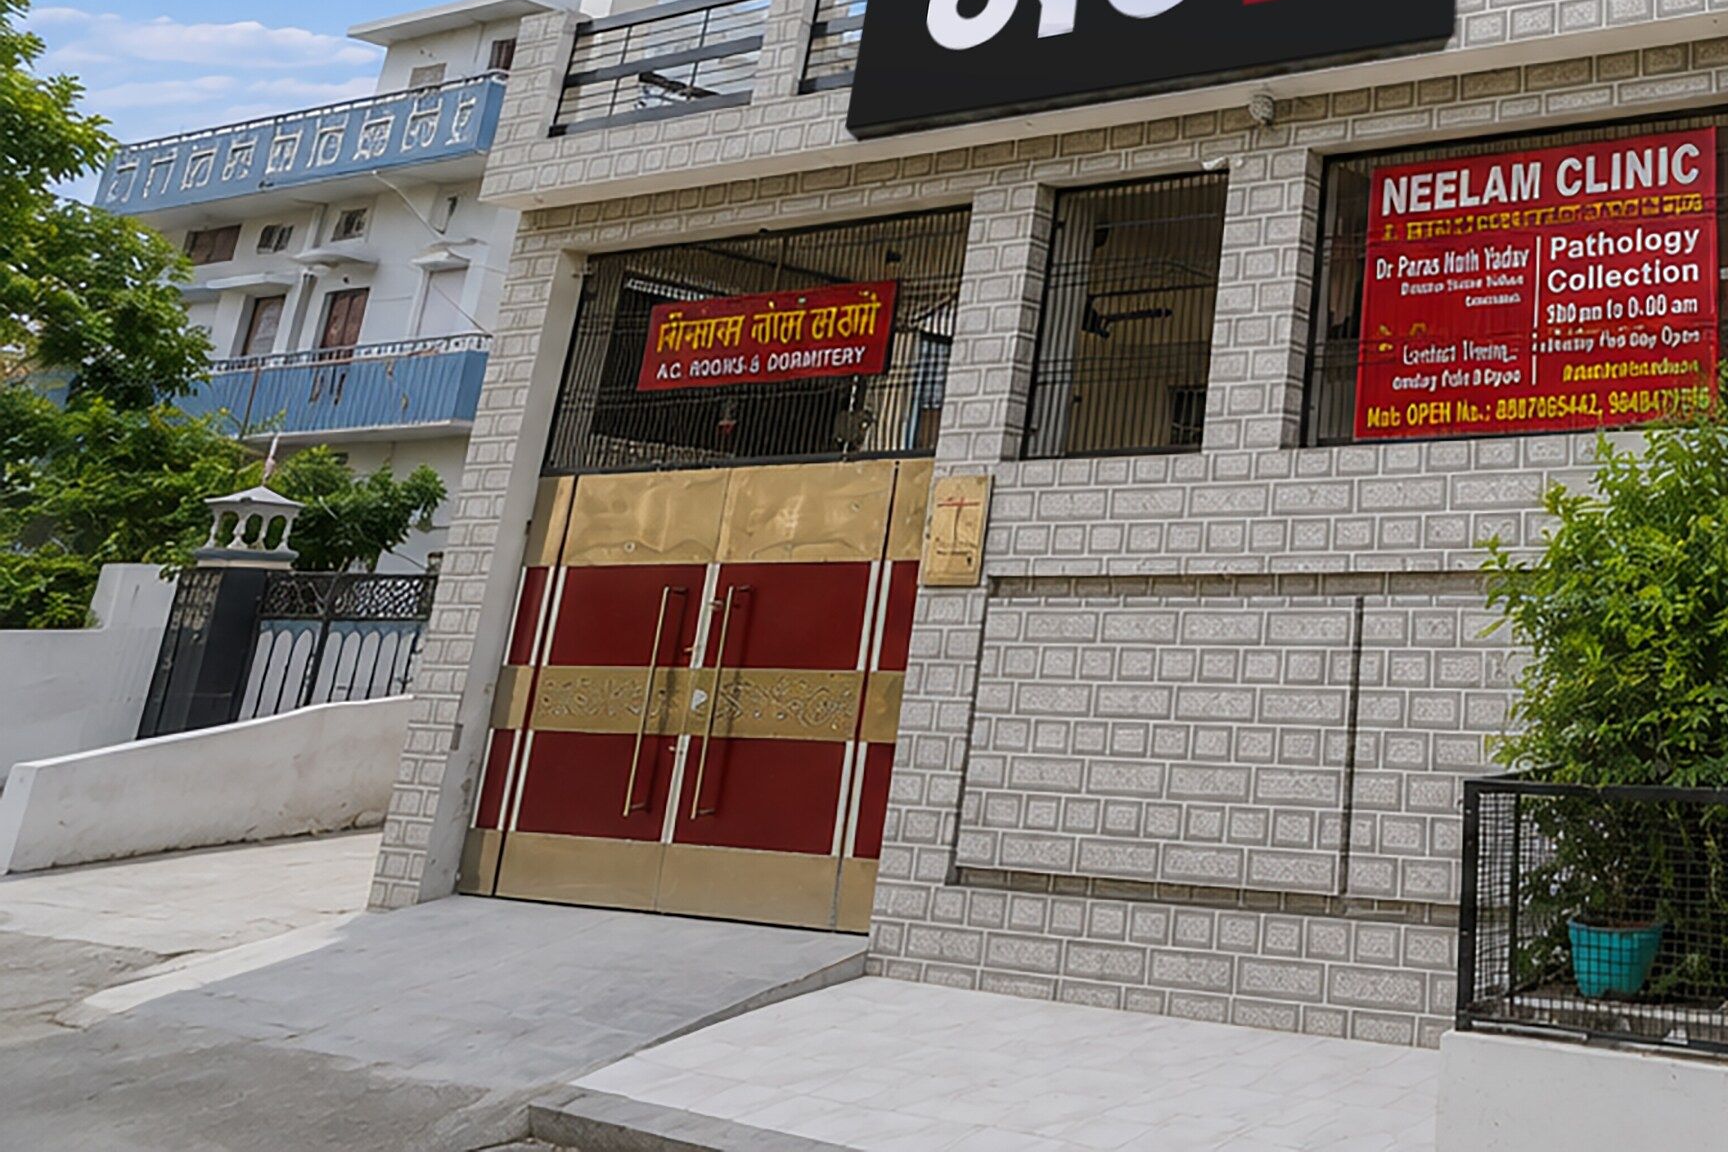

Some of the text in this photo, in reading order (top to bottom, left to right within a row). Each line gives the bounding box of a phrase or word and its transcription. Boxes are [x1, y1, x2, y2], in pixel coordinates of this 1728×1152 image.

[1381, 142, 1701, 216] NEELAM CLINIC
[1550, 226, 1701, 261] Pathology
[1547, 259, 1700, 293] Collection
